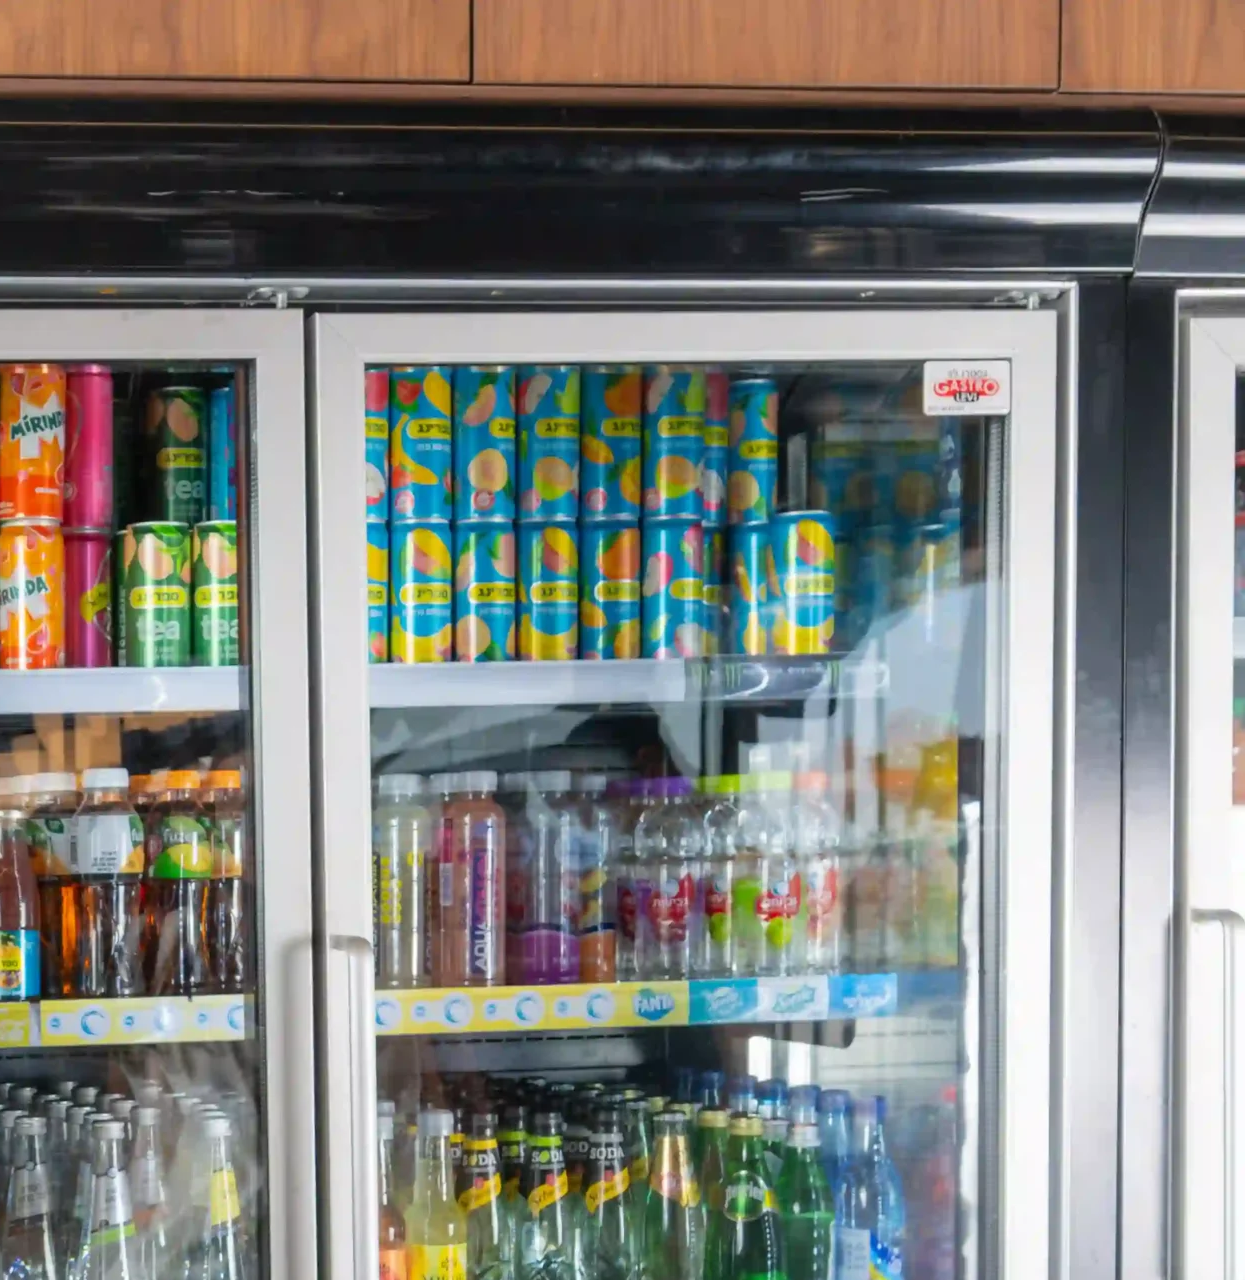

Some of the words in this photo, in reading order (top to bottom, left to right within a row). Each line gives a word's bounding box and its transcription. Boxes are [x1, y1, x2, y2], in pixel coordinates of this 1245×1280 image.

[164, 478, 204, 501] tea
[136, 615, 181, 641] tea
[589, 1146, 625, 1160] SODA
